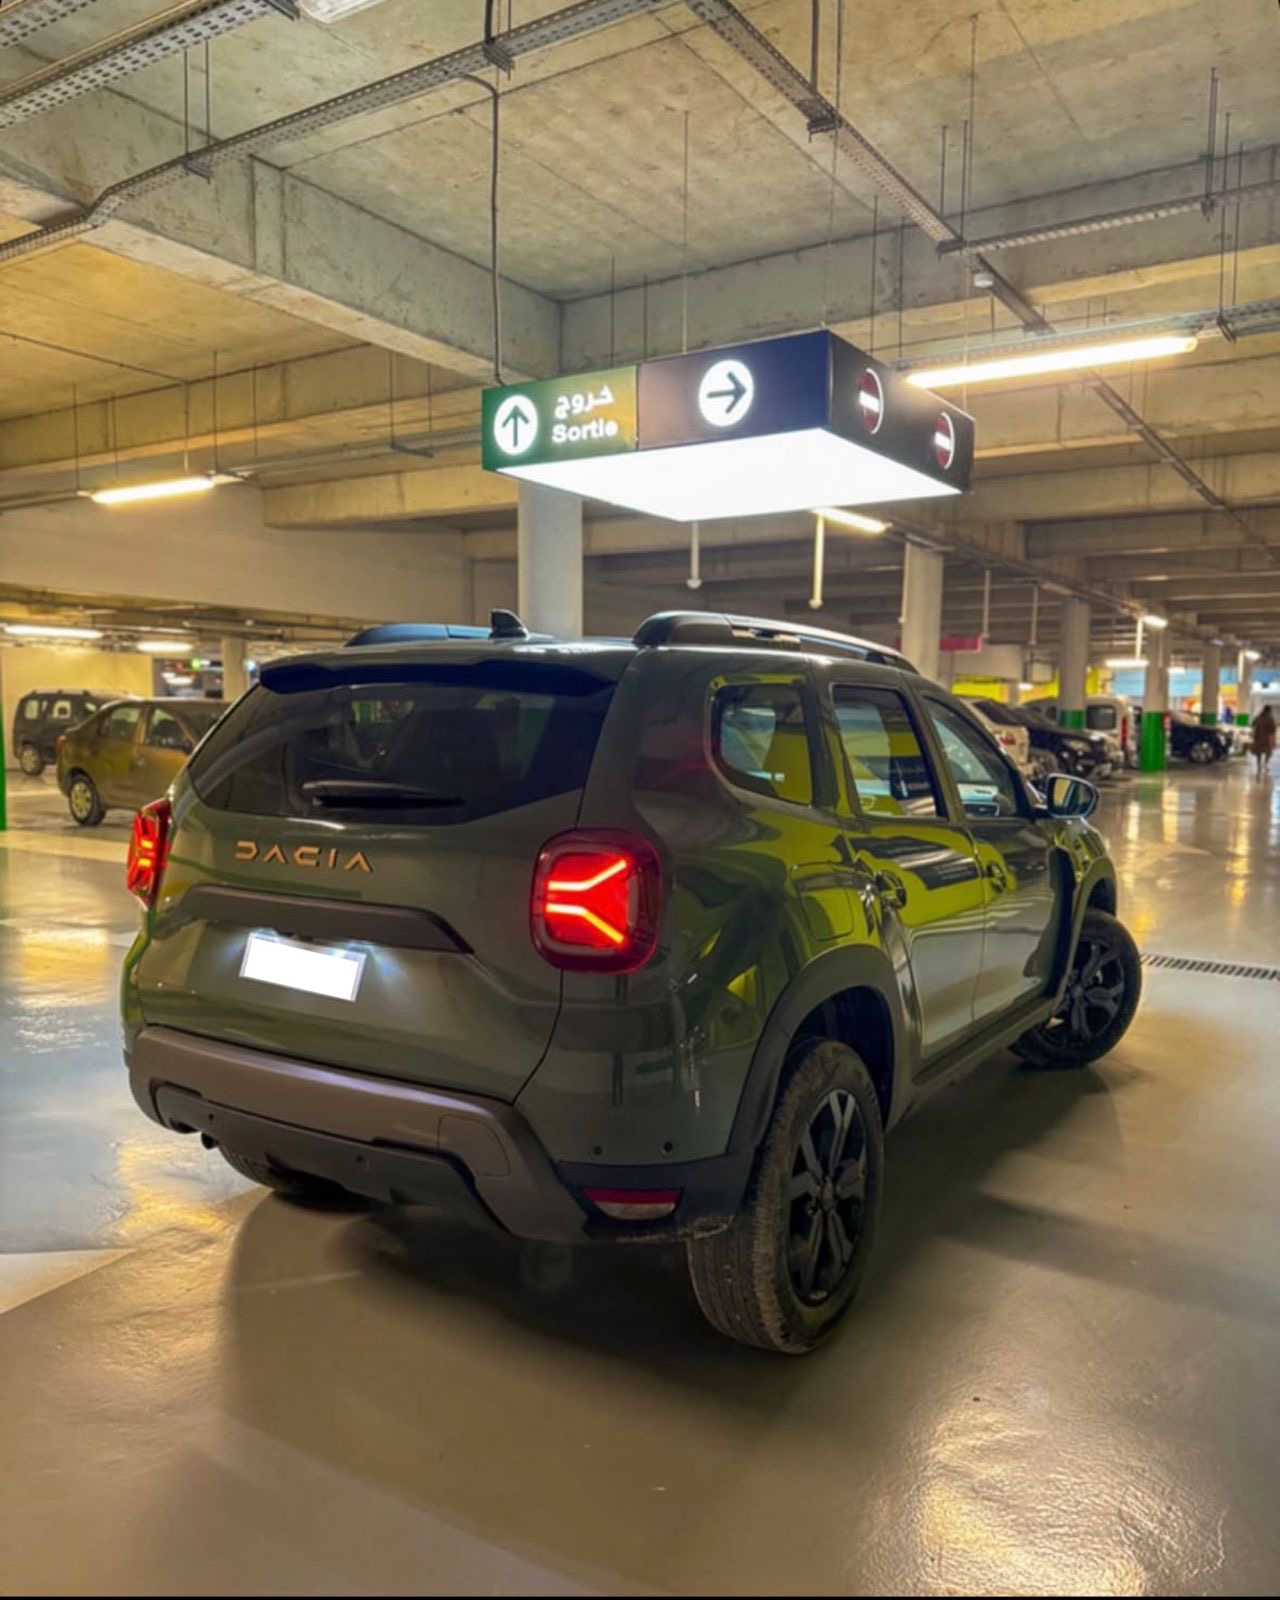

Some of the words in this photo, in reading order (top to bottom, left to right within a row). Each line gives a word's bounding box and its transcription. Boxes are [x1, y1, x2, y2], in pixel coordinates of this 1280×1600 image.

[554, 384, 615, 420] خروج
[552, 418, 619, 443] Sortie
[235, 840, 373, 872] DACIA
